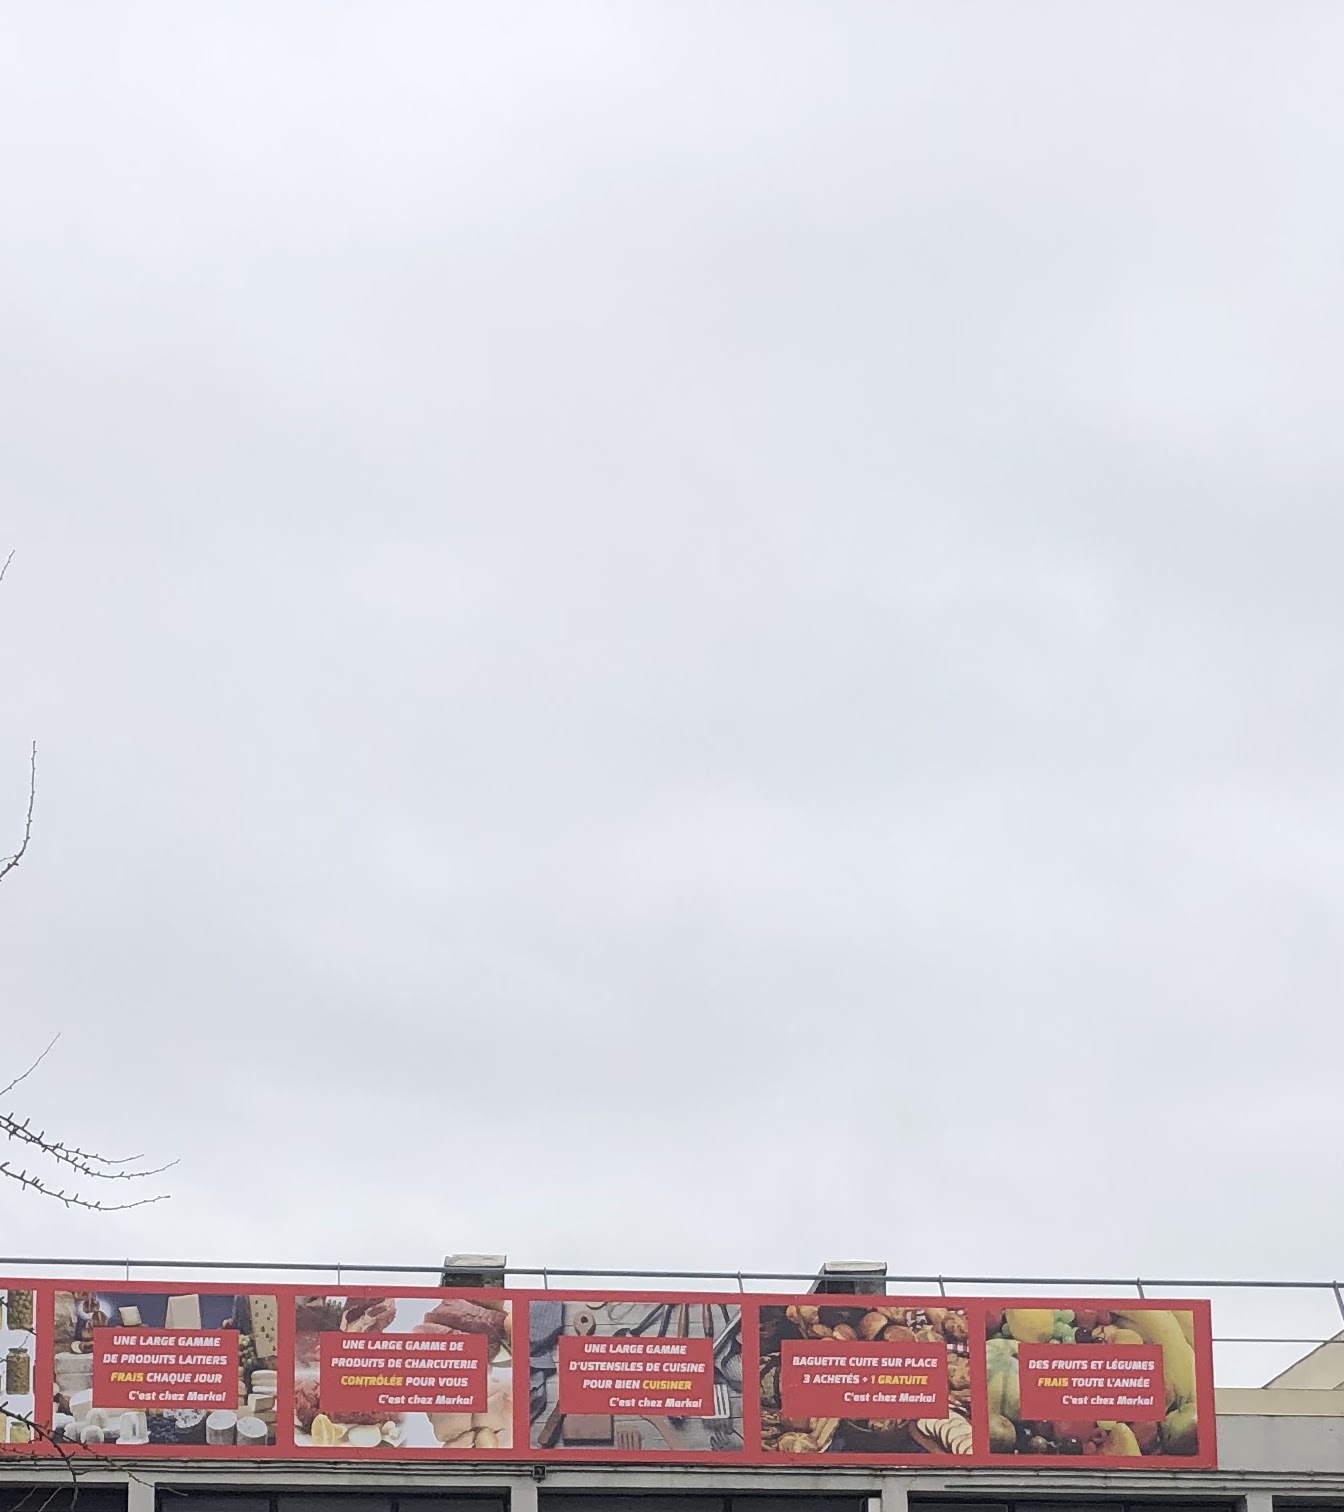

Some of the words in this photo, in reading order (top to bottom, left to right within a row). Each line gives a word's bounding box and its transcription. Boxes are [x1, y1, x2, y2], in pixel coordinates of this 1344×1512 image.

[113, 1335, 137, 1346] UNE
[139, 1336, 177, 1346] LARGE
[177, 1336, 221, 1347] GAMME
[342, 1339, 366, 1349] UNE
[367, 1340, 403, 1350] LARGE
[404, 1340, 446, 1351] GAMME
[448, 1341, 465, 1351] DE
[584, 1343, 607, 1353] UNE
[609, 1344, 644, 1354] LARGE
[645, 1344, 688, 1355] GAMME
[103, 1353, 119, 1364] DE
[120, 1354, 176, 1365] PRODUITS
[178, 1355, 228, 1365] LAITIERS
[330, 1357, 385, 1368] PRODUITS
[387, 1358, 402, 1368] DE
[404, 1358, 478, 1369] CHARCUTERIE
[792, 1356, 847, 1367] BAGUETTE
[848, 1357, 879, 1367] CUITE
[880, 1357, 903, 1367] SUR
[904, 1357, 938, 1368] PLACE
[1028, 1359, 1050, 1370] DES
[1051, 1360, 1088, 1370] FRUITS
[1090, 1360, 1104, 1370] ET
[1105, 1358, 1155, 1371] LÉGUMES
[569, 1361, 644, 1371] D'USTENSILES
[645, 1362, 660, 1372] DE
[662, 1363, 706, 1373] CUISINE
[110, 1372, 144, 1382] FRAIS
[146, 1372, 193, 1385] CHAQUE
[194, 1373, 223, 1383] JOUR
[340, 1373, 404, 1386] CONTRÔLÉE
[405, 1376, 436, 1387] POUR
[438, 1377, 469, 1387] VOUS
[582, 1379, 612, 1389] POUR
[614, 1379, 641, 1390] BIEN
[642, 1380, 692, 1390] CUISINER
[802, 1373, 811, 1384] 3
[812, 1372, 860, 1384] ACHETÉS
[870, 1375, 876, 1384] 1
[877, 1375, 929, 1385] GRATUITE
[1037, 1377, 1069, 1387] FRAIS
[1070, 1377, 1105, 1388] TOUTE
[1106, 1376, 1151, 1388] L'ANNÉE
[128, 1390, 156, 1401] C'est
[158, 1390, 185, 1401] chez
[378, 1393, 406, 1404] C'est
[407, 1394, 433, 1405] chez
[843, 1391, 870, 1402] C'est
[872, 1391, 897, 1402] chez
[1062, 1394, 1089, 1405] C'est
[1090, 1394, 1115, 1406] chez
[609, 1397, 636, 1407] C'est
[637, 1397, 663, 1408] chez
